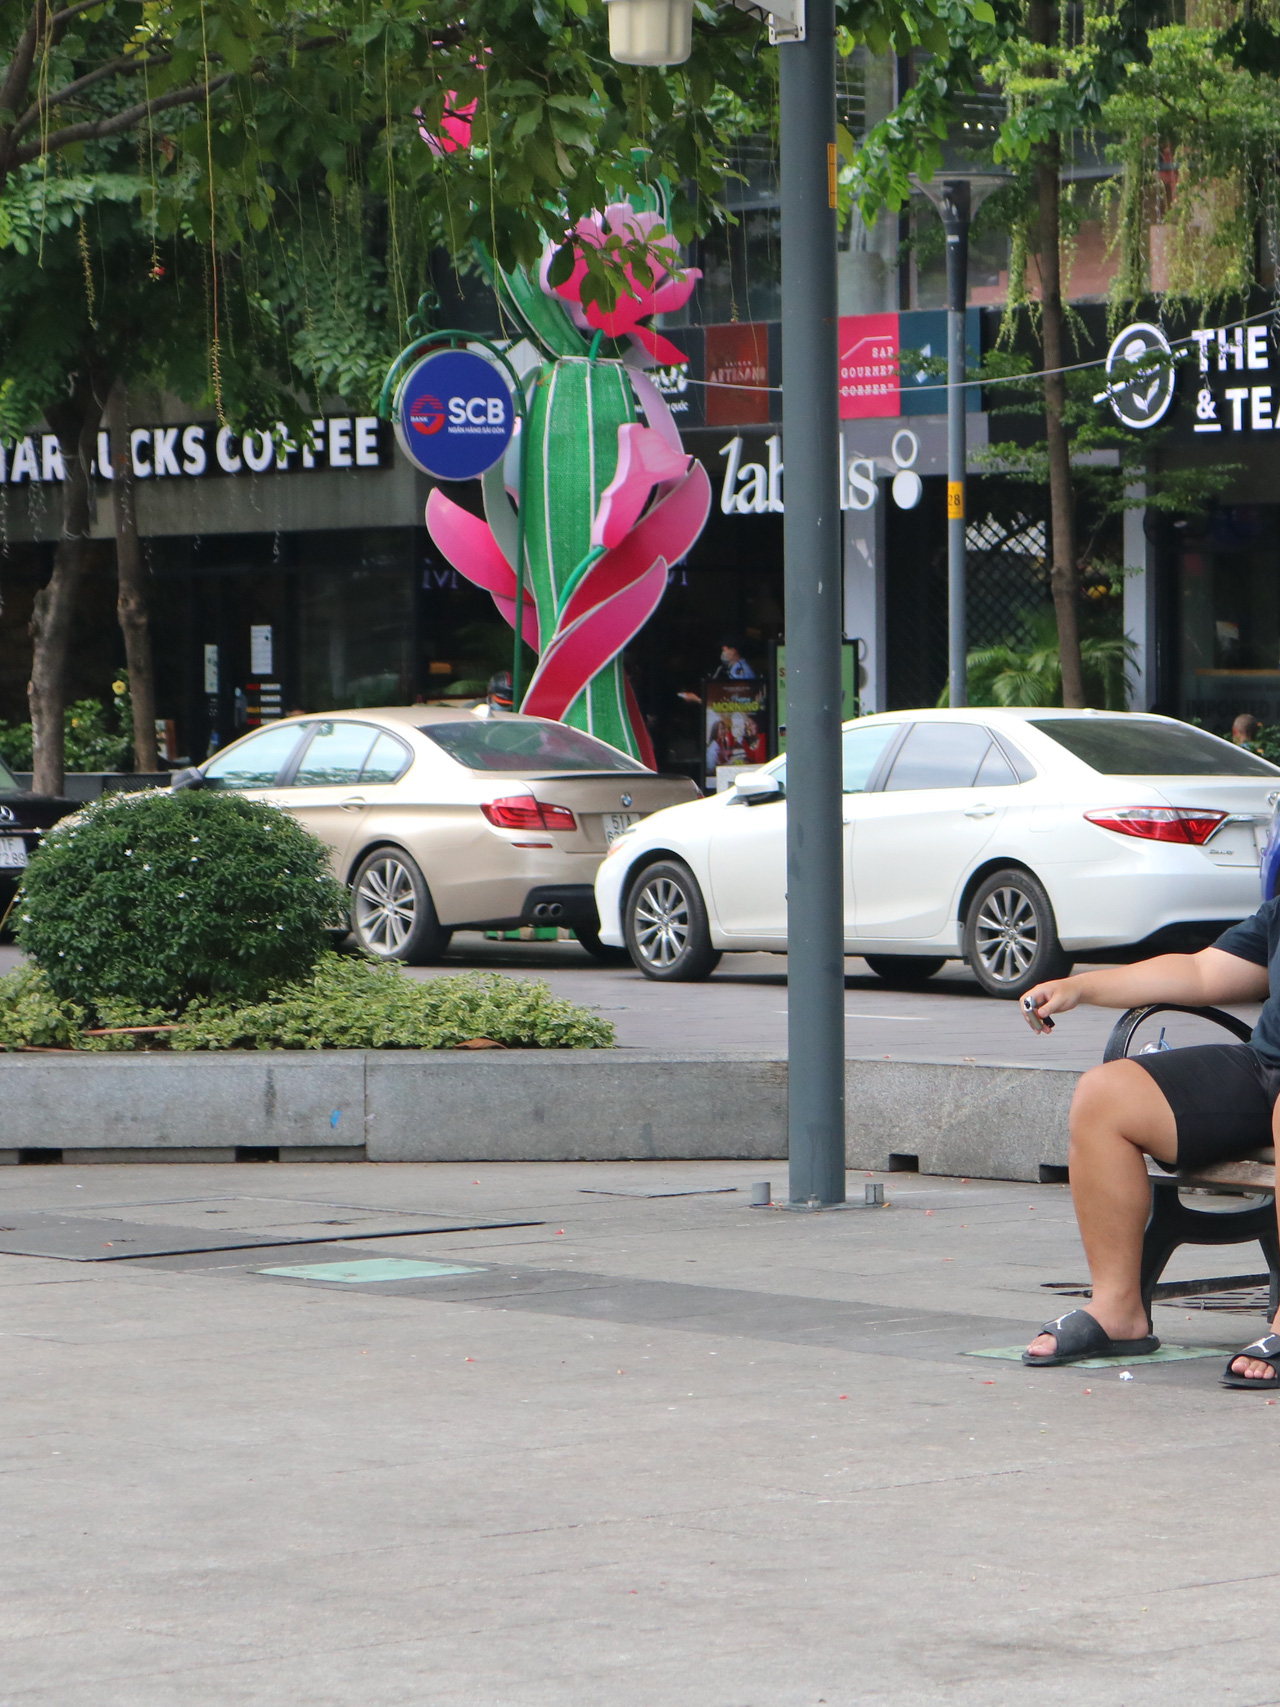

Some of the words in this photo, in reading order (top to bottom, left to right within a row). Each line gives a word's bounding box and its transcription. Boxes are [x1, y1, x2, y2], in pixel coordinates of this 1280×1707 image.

[1192, 325, 1269, 372] THE
[448, 397, 505, 425] SCB
[215, 416, 379, 474] COFFEE
